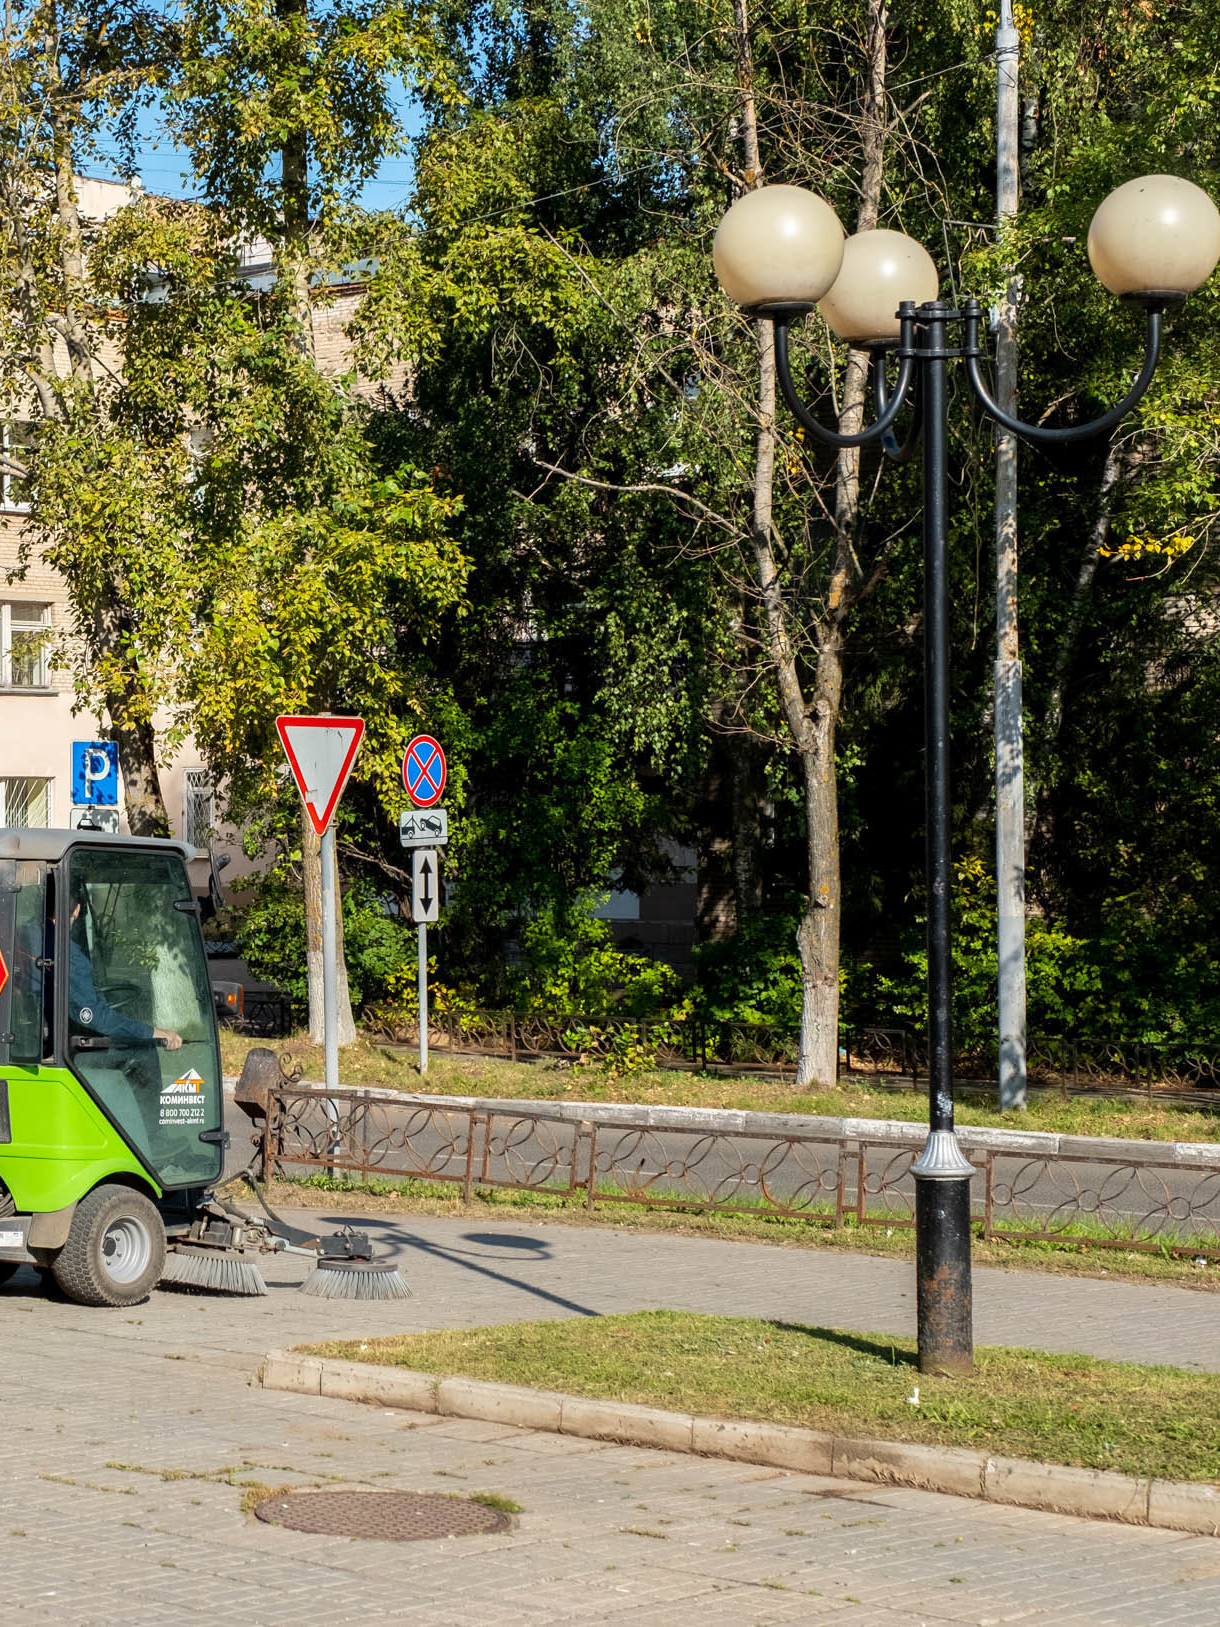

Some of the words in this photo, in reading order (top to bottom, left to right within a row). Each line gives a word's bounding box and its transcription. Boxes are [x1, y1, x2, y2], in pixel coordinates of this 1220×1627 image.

[85, 748, 110, 798] P
[159, 1095, 205, 1105] КОМИНВЕСТ
[160, 1108, 165, 1117] 8
[165, 1108, 178, 1117] 800
[179, 1108, 190, 1117] 700
